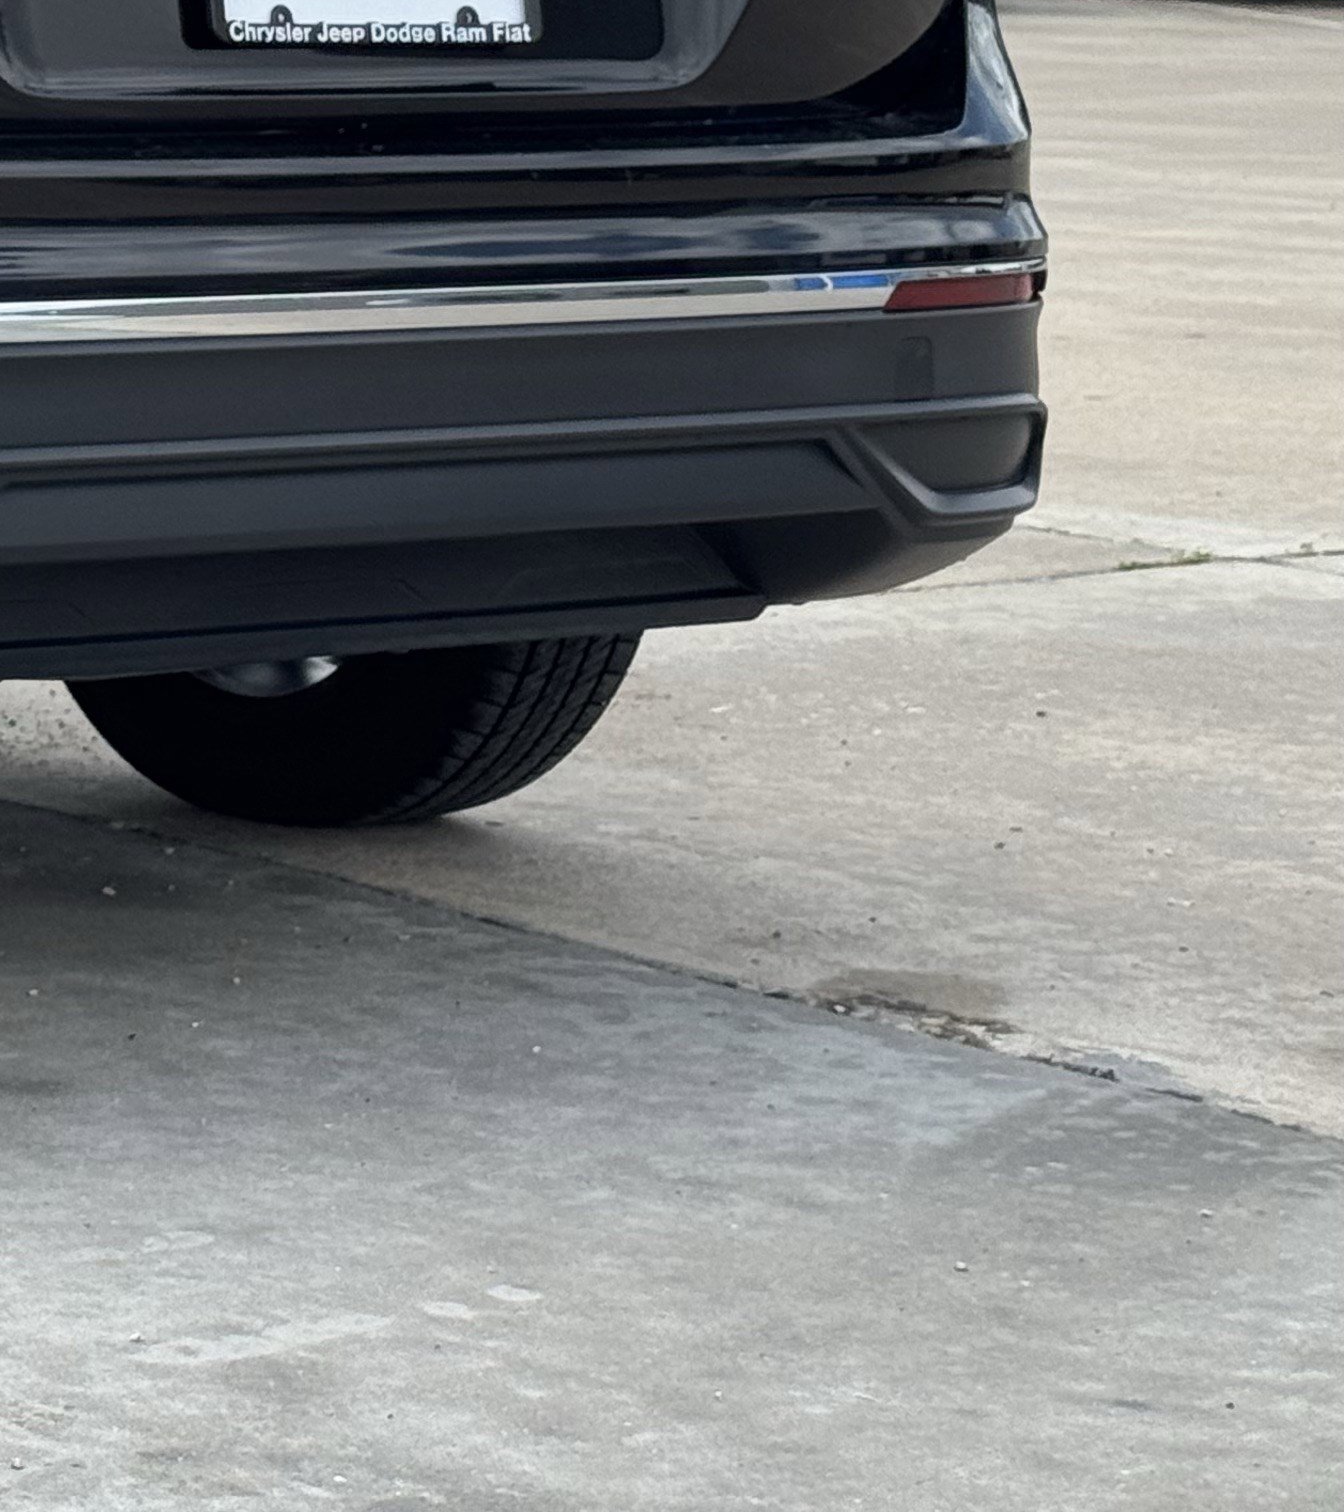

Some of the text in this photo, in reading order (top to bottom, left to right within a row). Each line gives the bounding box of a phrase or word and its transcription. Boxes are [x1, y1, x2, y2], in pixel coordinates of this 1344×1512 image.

[229, 20, 532, 44] Chrysler Jeep Dodge Ram Fiat
